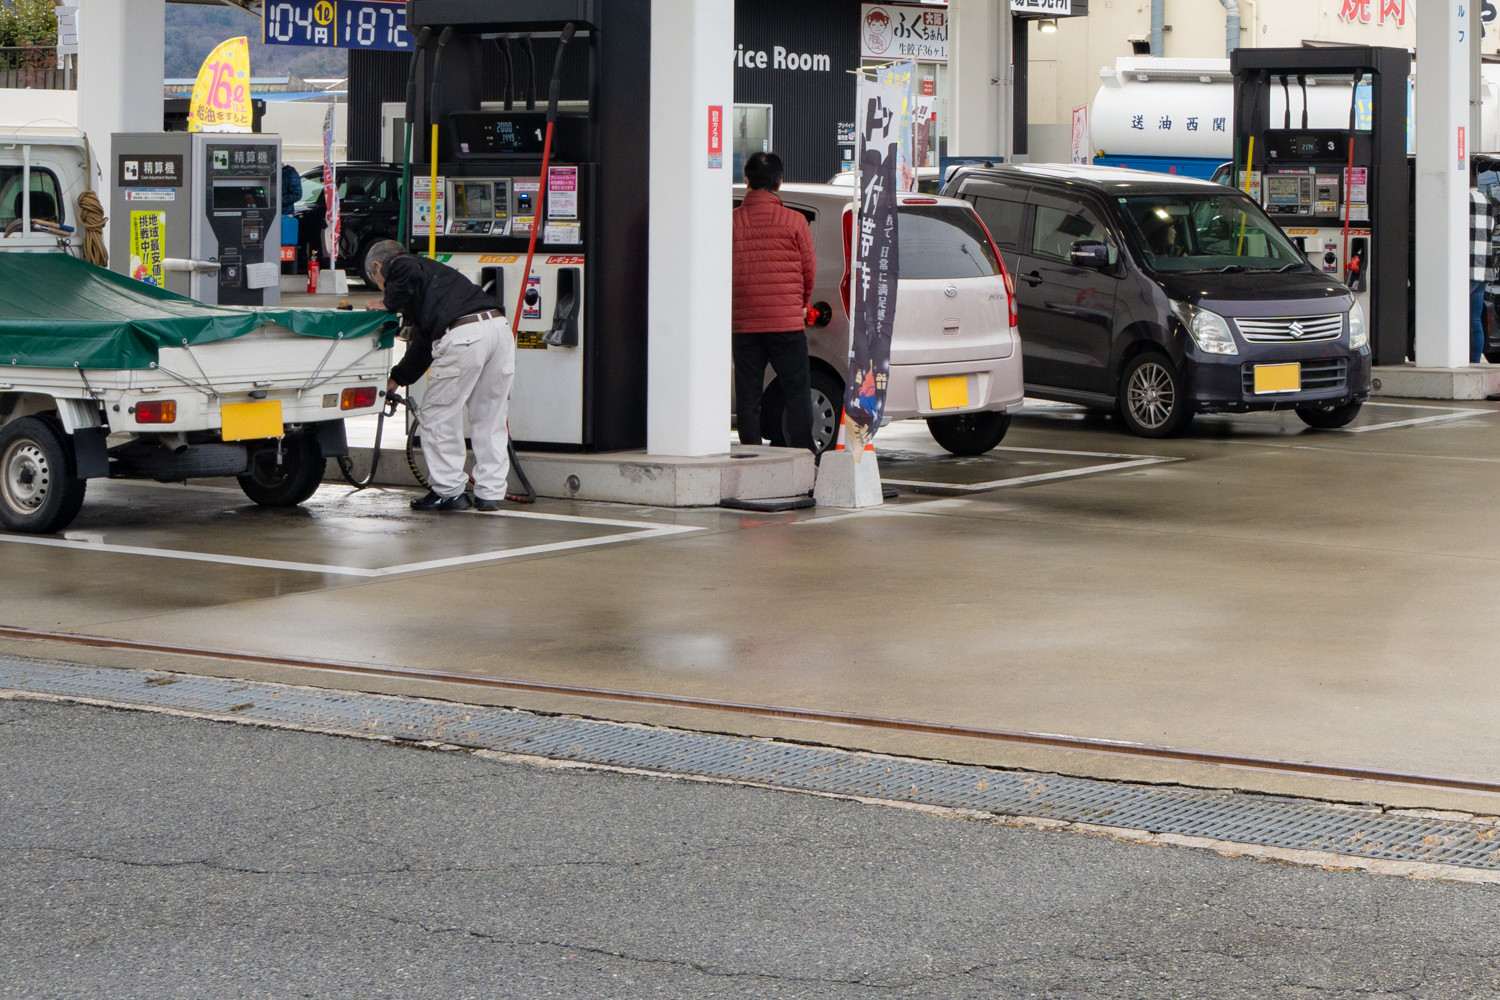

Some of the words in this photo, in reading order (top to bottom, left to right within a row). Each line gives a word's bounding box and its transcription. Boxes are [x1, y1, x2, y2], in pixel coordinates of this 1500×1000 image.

[269, 3, 312, 42] 104
[925, 13, 943, 26] 大阪
[894, 12, 948, 41] ふくちぁん
[315, 27, 328, 44] 円
[899, 44, 948, 57] 生餃子36ヶ1,
[774, 46, 830, 72] Room
[535, 128, 543, 141] 1
[1327, 141, 1335, 150] 3
[234, 151, 268, 164] 精算機
[143, 161, 175, 174] 精算機
[148, 214, 162, 286] 地域最安値に
[550, 256, 585, 264] レギュラー
